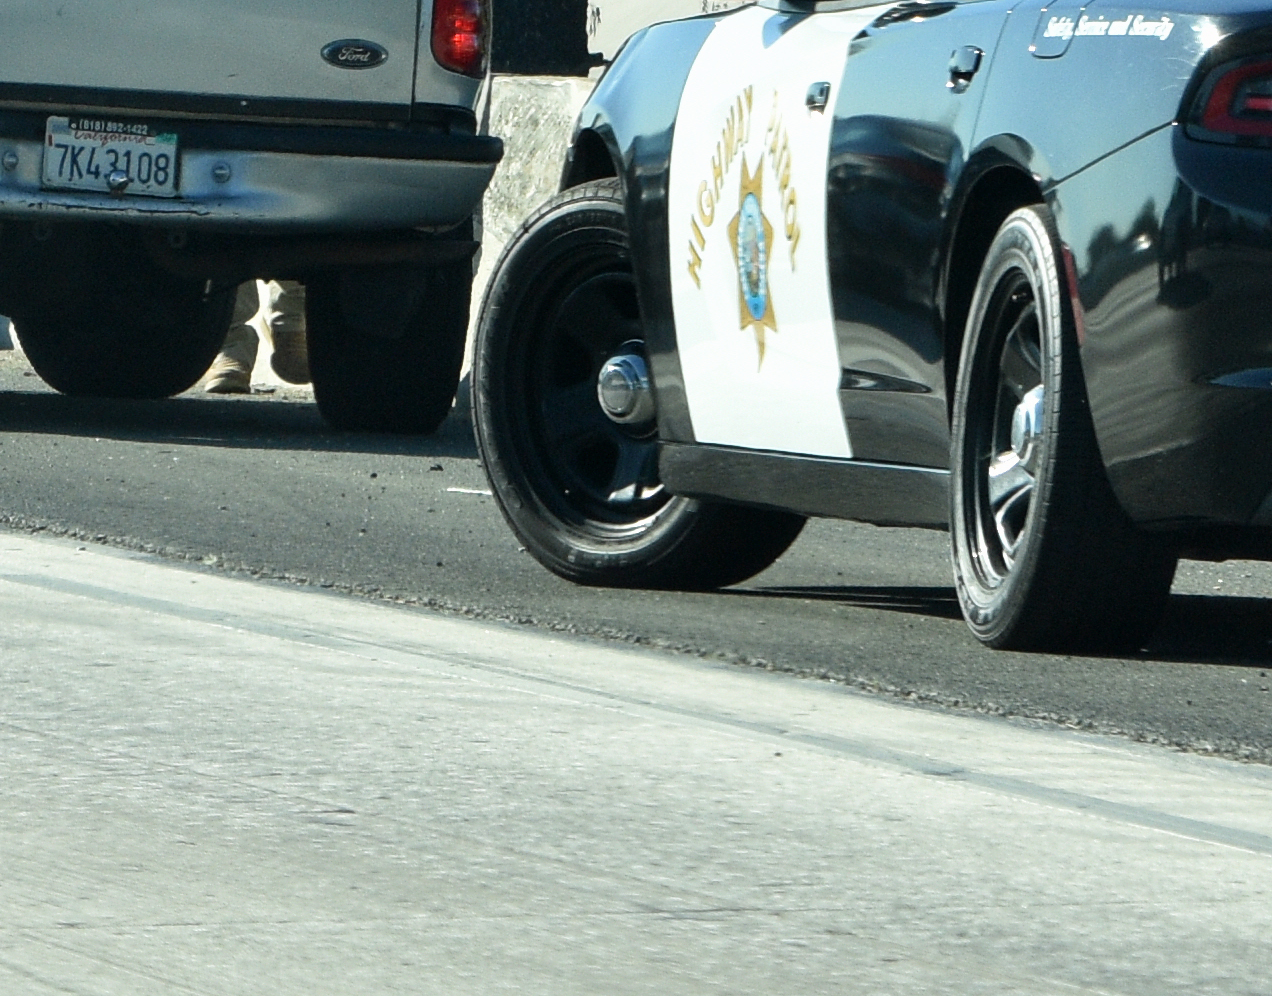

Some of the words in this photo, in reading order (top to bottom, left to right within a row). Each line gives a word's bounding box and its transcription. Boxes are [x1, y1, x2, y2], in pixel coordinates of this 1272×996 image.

[338, 47, 371, 62] Ford
[73, 130, 156, 147] California
[54, 143, 170, 186] 7K43108
[687, 83, 753, 291] HIGHWAY
